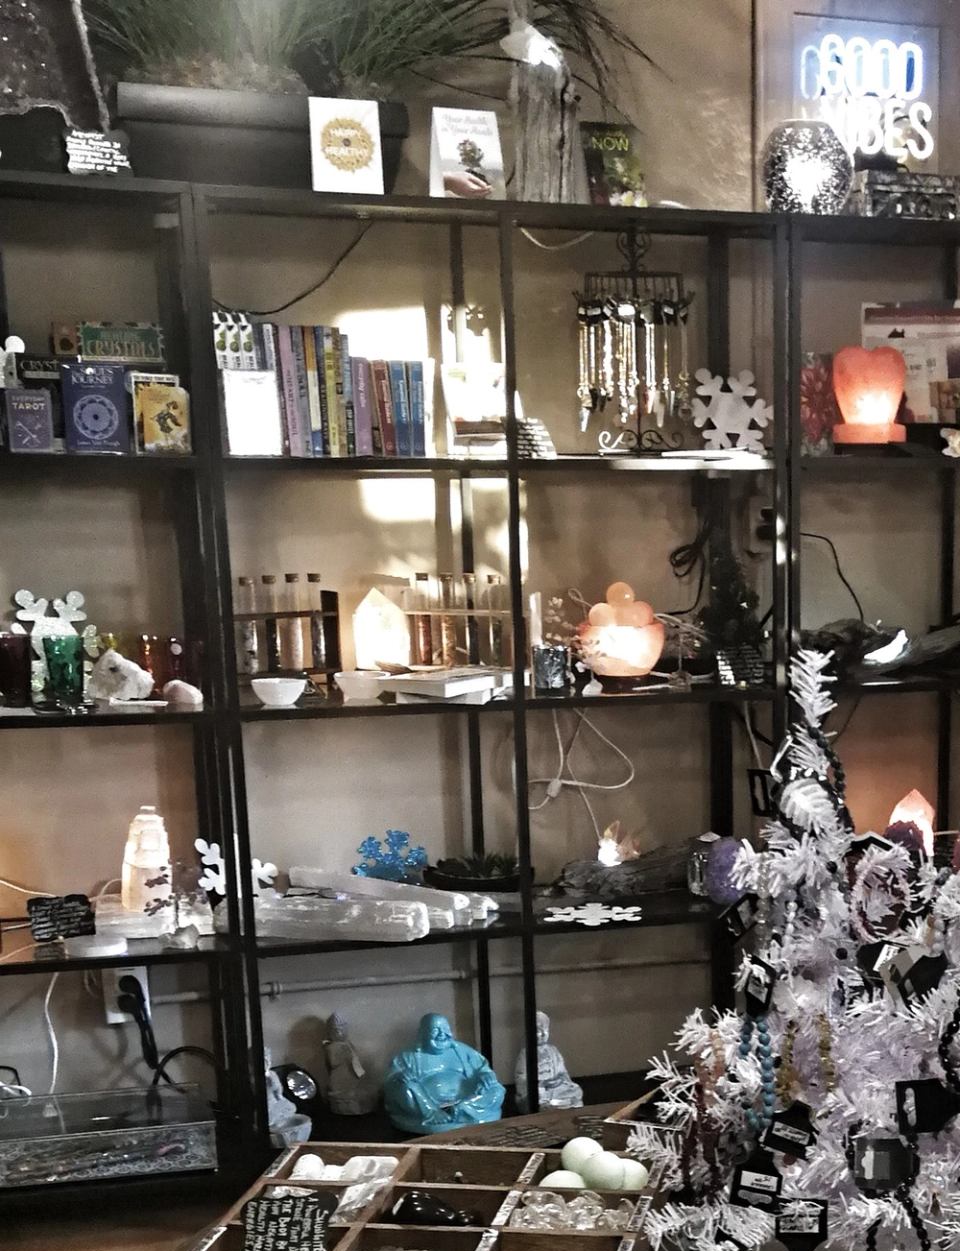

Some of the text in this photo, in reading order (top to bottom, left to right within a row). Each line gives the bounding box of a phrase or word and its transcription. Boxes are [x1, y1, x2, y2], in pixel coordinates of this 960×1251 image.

[822, 34, 924, 100] GOOD
[591, 136, 629, 152] NOW
[12, 402, 46, 410] TAROT
